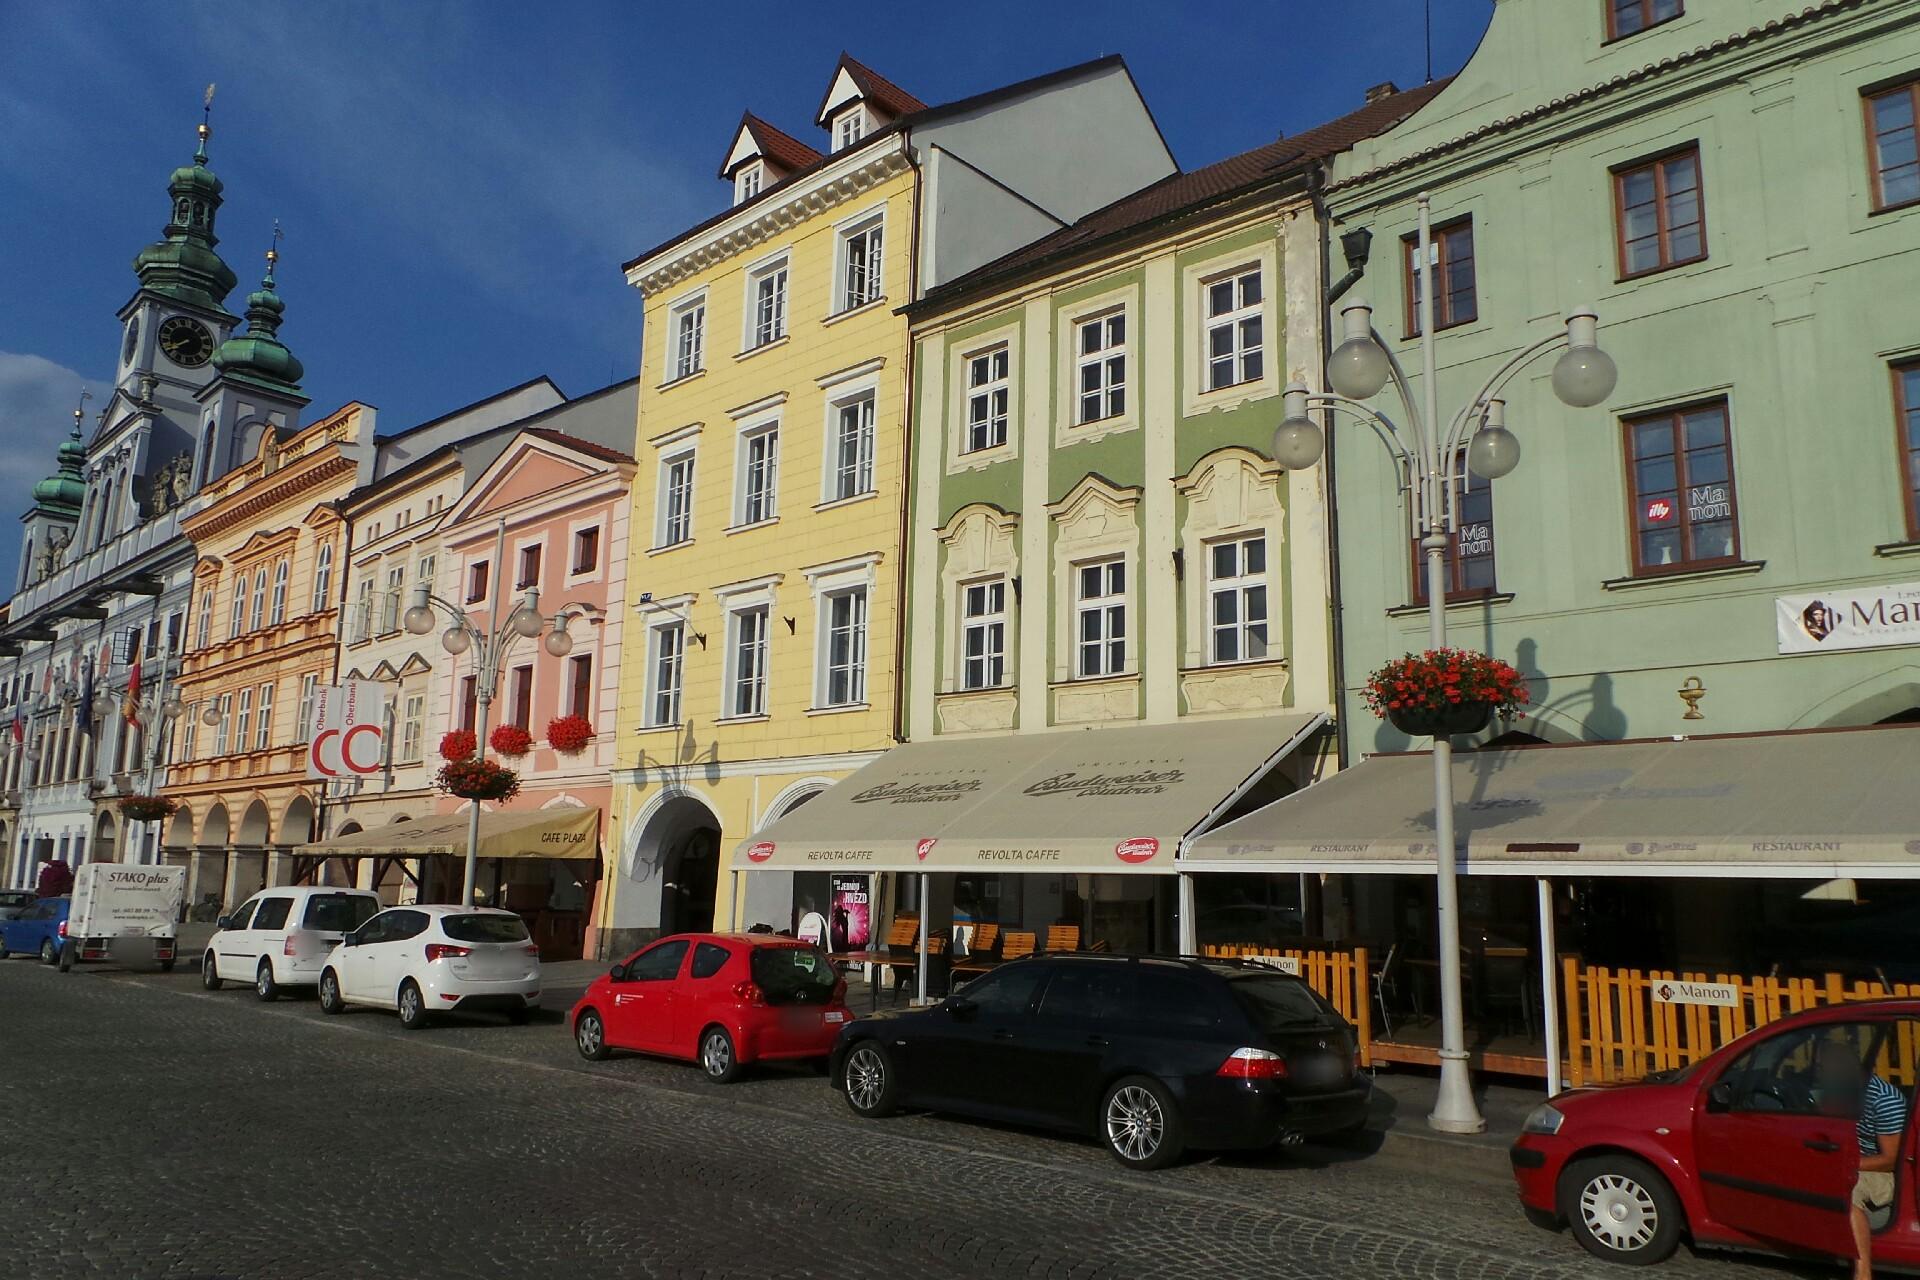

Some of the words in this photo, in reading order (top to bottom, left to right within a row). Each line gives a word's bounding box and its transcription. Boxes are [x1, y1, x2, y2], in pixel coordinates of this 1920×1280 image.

[1692, 486, 1726, 506] Ma
[1648, 502, 1670, 518] illy
[1688, 502, 1731, 521] non
[1461, 524, 1489, 542] Ma
[1459, 539, 1492, 556] non
[316, 688, 328, 731] Oberbank
[346, 682, 357, 726] Oberbank
[1023, 768, 1185, 796] Budweiser
[541, 832, 561, 843] CAFE
[562, 833, 586, 843] PLAZA
[976, 849, 1023, 860] REVOLTA
[1025, 849, 1060, 860] CAFFE
[1310, 844, 1370, 852] RESTAURANT
[1752, 842, 1842, 851] RESTAURANT
[807, 851, 843, 860] REVOLTA
[845, 850, 872, 860] CAFFE
[109, 872, 146, 884] STAKO
[146, 873, 169, 886] plus
[1680, 985, 1731, 999] Manon
